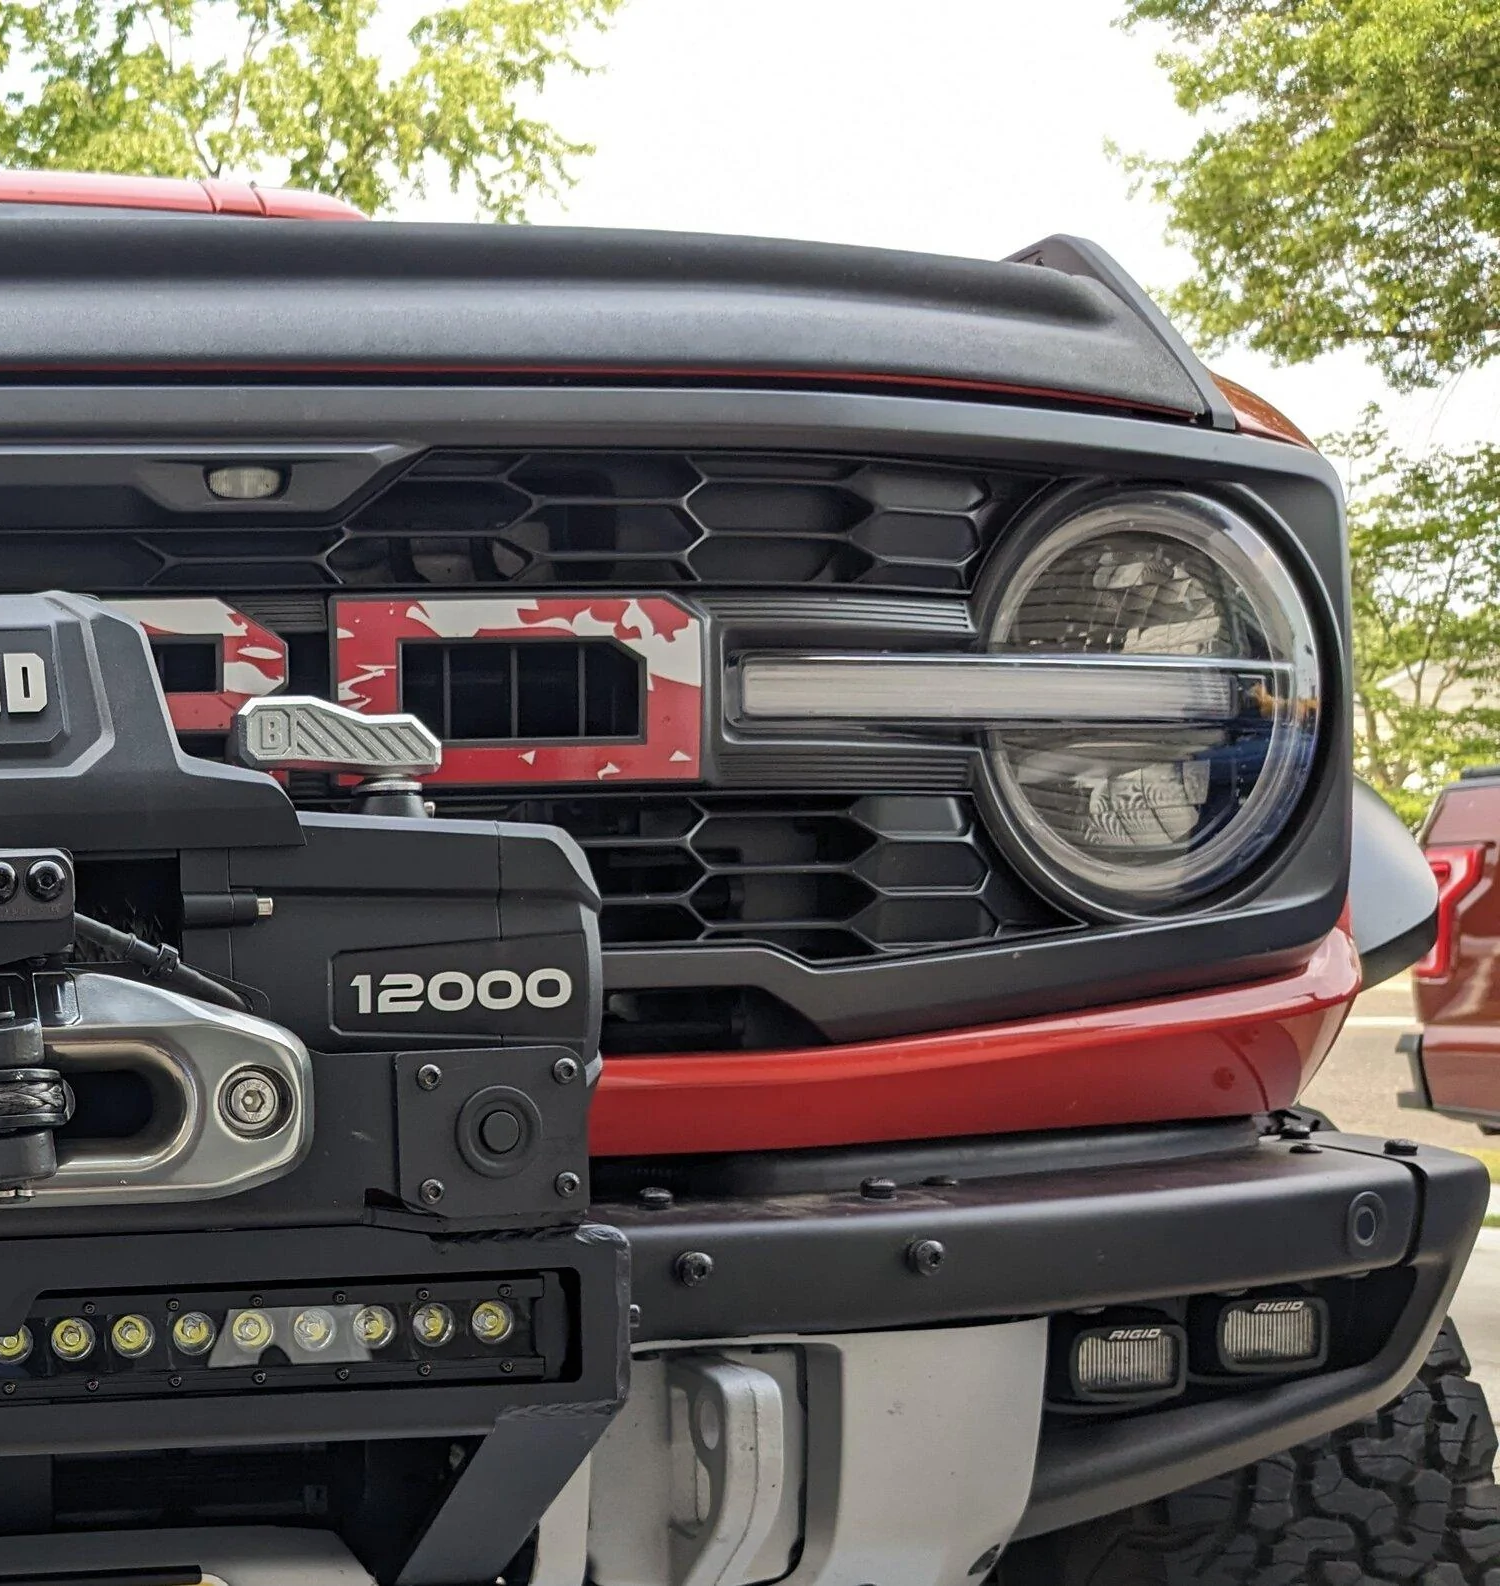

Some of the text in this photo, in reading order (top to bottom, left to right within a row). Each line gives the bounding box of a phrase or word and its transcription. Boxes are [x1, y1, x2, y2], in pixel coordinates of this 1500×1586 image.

[350, 968, 572, 1014] 12000
[1253, 1301, 1304, 1313] RIGID
[1108, 1328, 1161, 1340] RIGID
